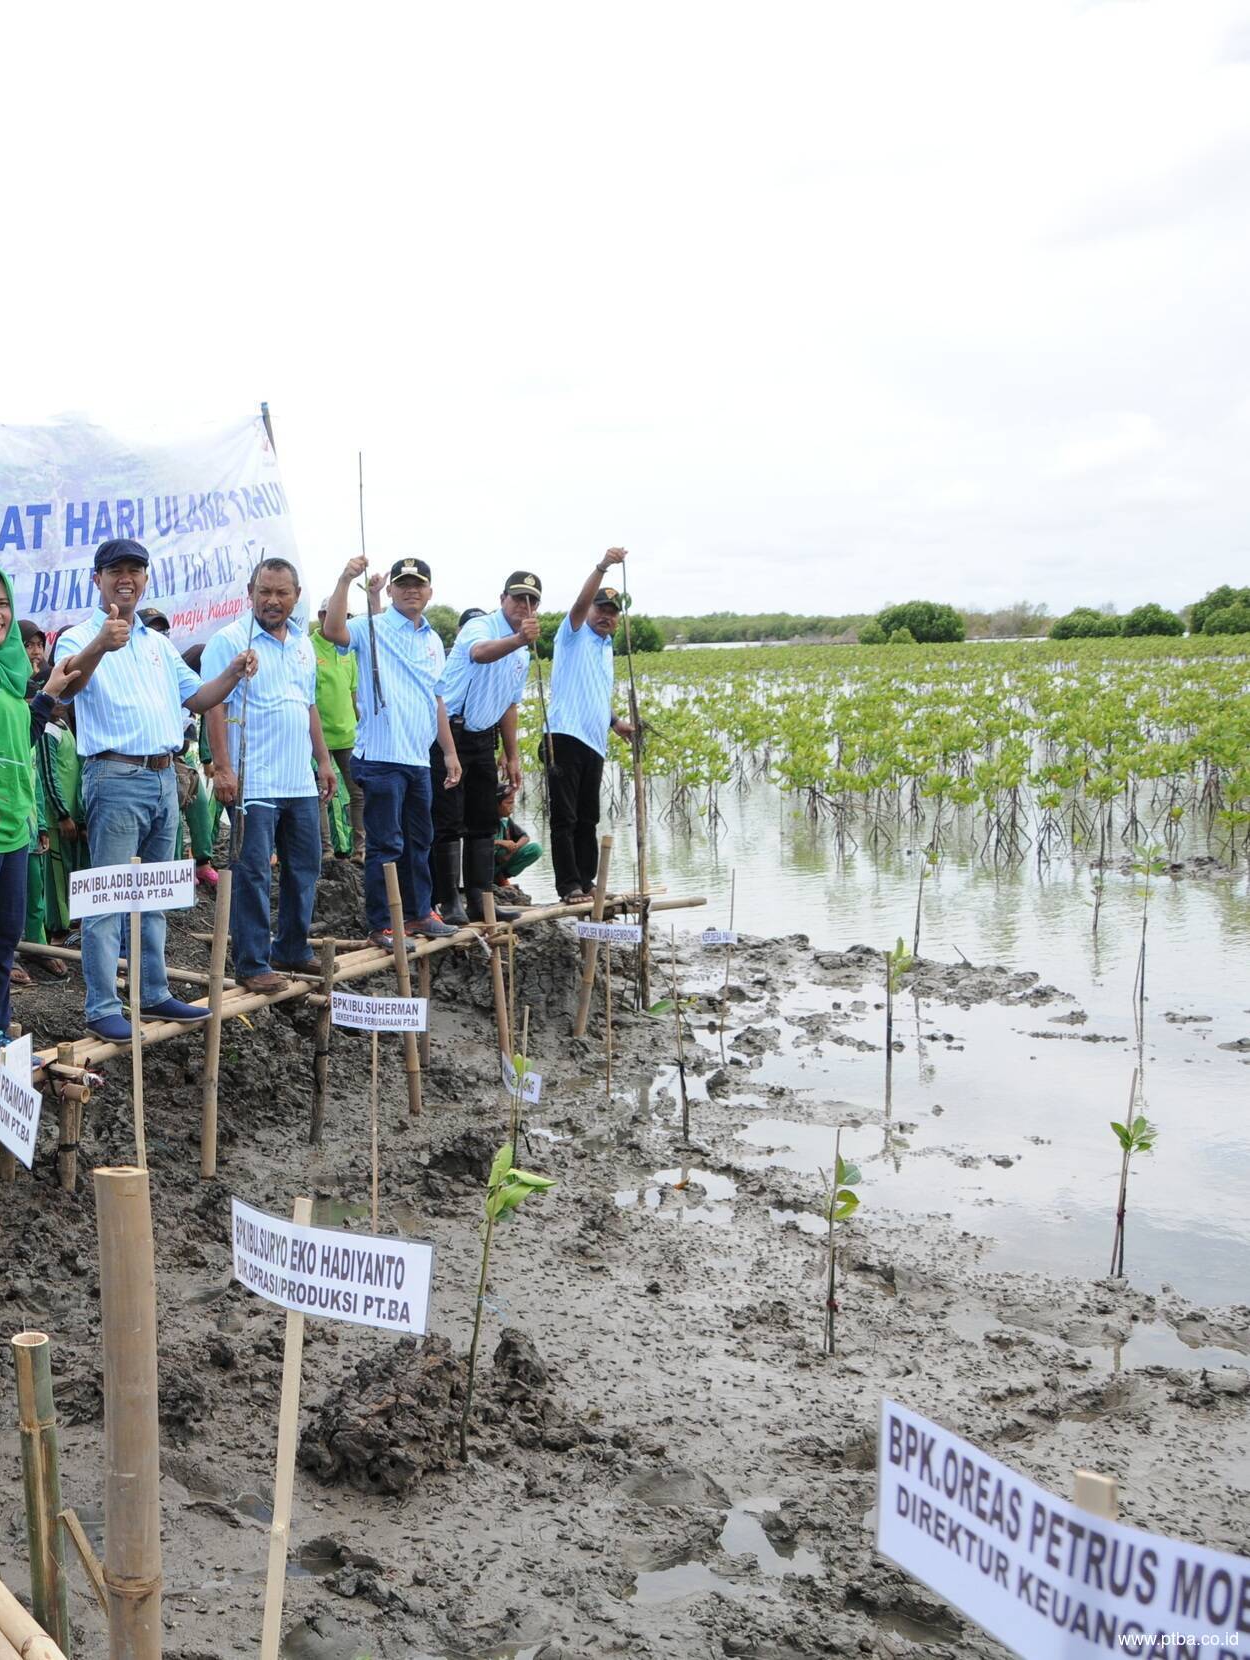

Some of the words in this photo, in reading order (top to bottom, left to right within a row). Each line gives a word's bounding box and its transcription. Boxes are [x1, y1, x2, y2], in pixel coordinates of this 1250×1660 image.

[65, 497, 146, 547] HARI
[154, 491, 231, 537] ULANG
[28, 567, 103, 613] BUKI
[171, 602, 204, 632] maju
[207, 591, 244, 622] hadapi
[92, 893, 111, 904] DIR.
[113, 890, 144, 901] NIAGA
[147, 888, 174, 899] PT.BA
[136, 867, 192, 887] UBAIDILLAH
[0, 1074, 35, 1121] PRAMONO
[11, 1115, 31, 1145] PT.BA
[289, 1239, 317, 1275] EKO
[320, 1244, 406, 1290] HADIYANTO
[362, 1295, 411, 1324] PT.BA
[888, 1414, 1023, 1543] BPK.OREAS
[1028, 1502, 1159, 1606] PETRUS
[896, 1484, 1010, 1591] DIREKTUR
